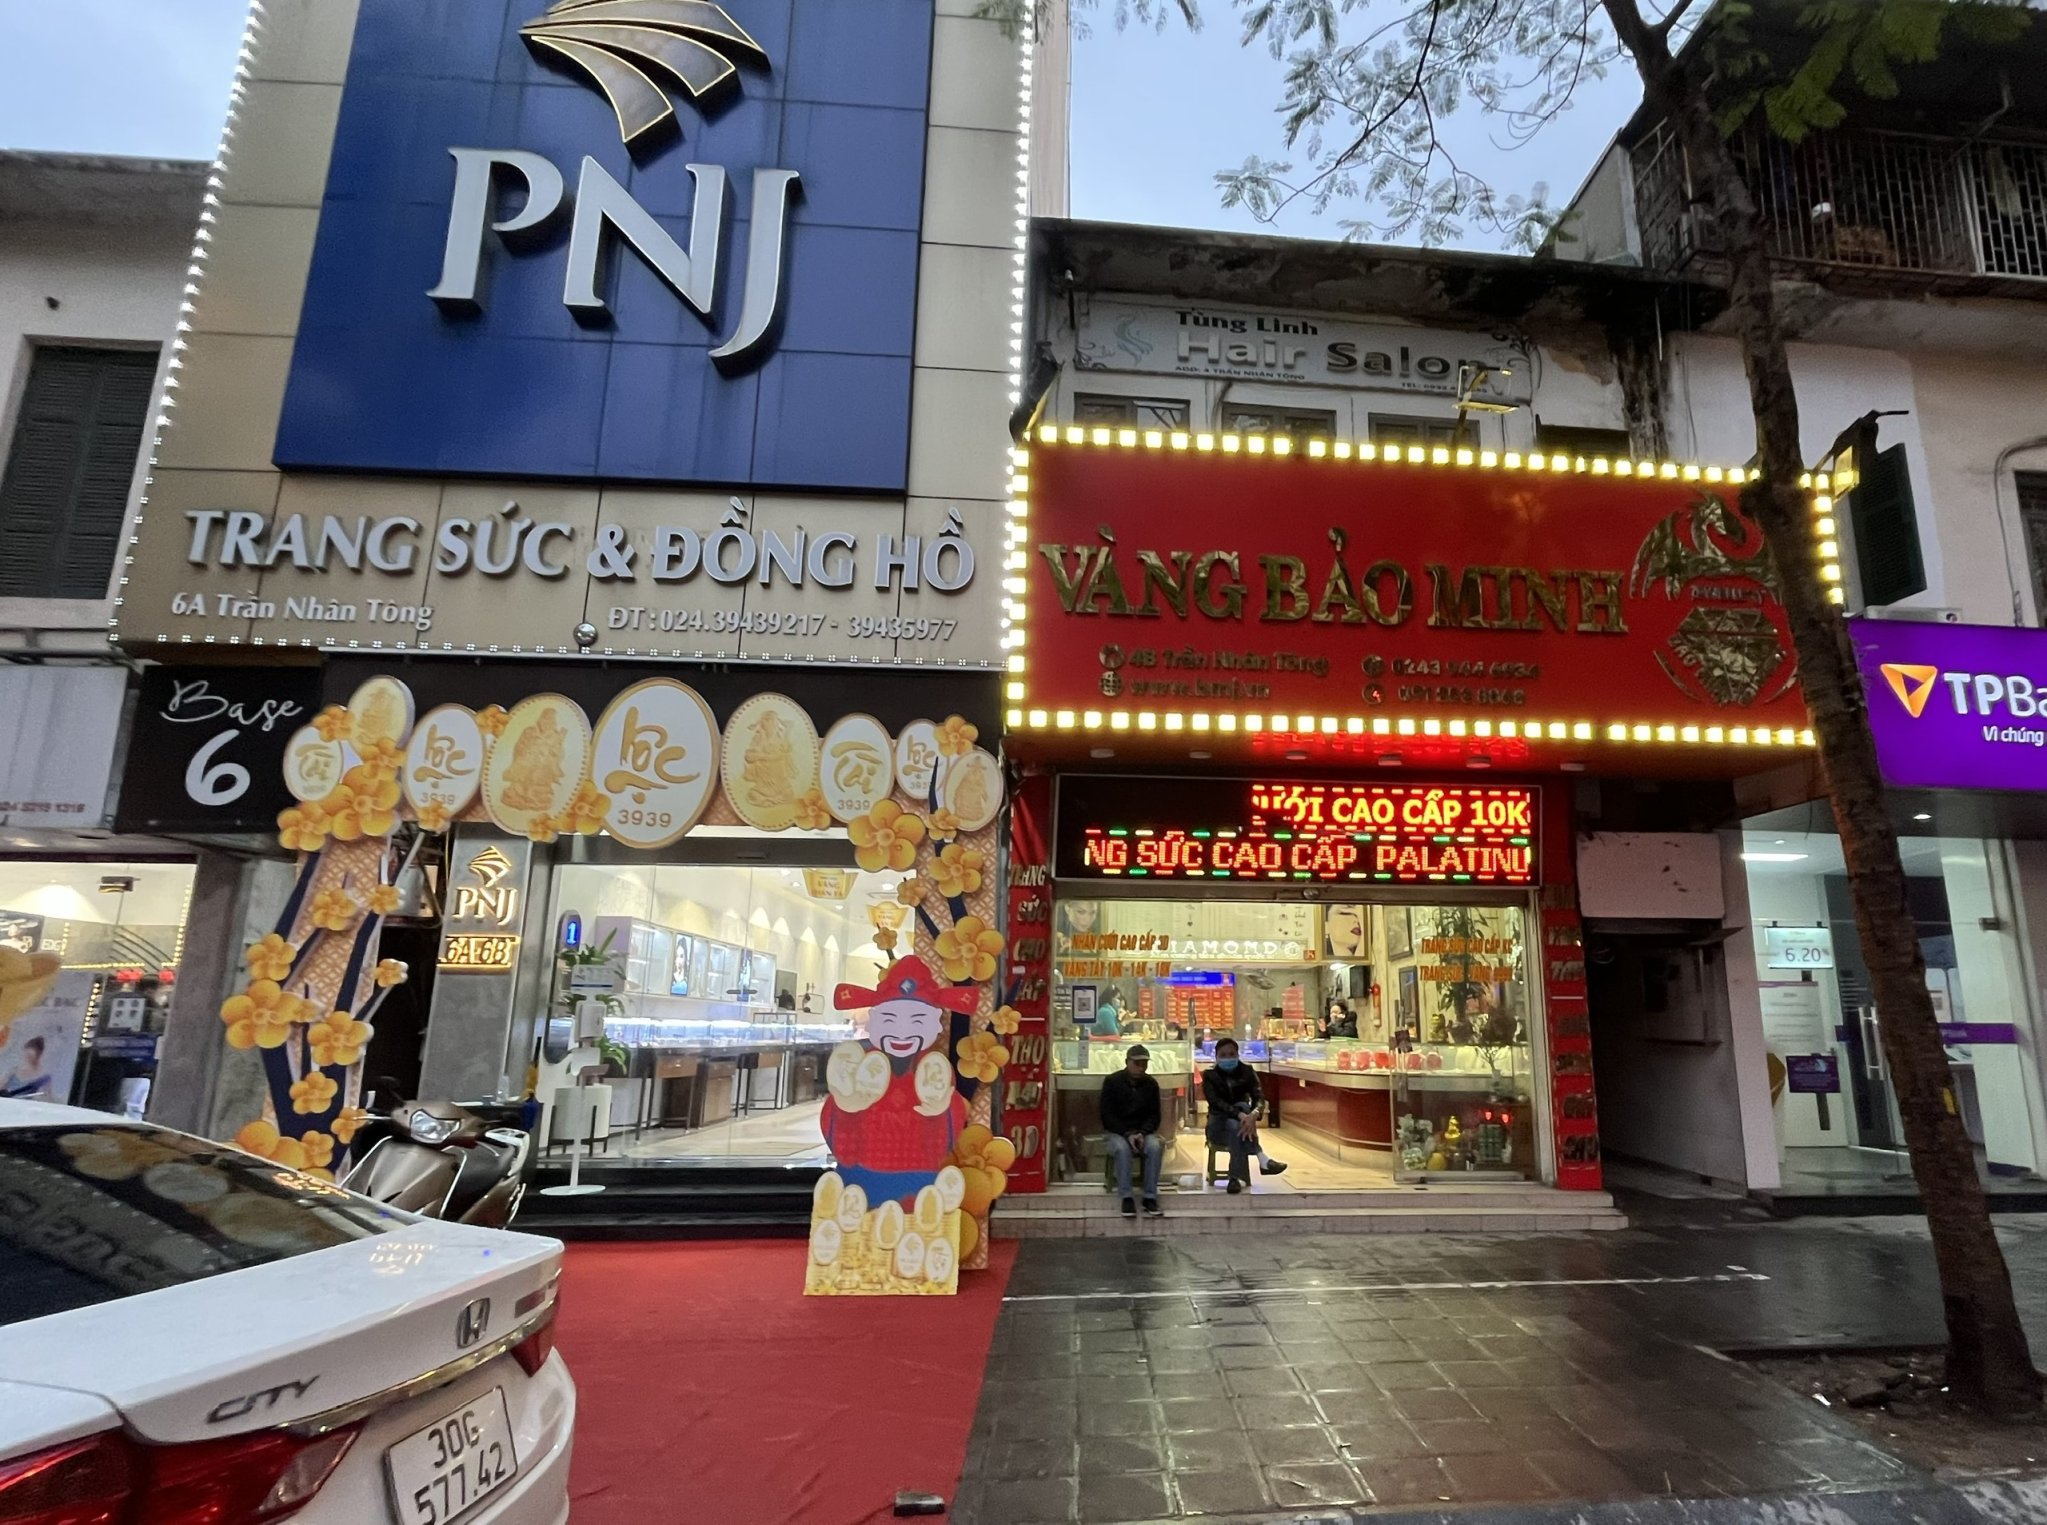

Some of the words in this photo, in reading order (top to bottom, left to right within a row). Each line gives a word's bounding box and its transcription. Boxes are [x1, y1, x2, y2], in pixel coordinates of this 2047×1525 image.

[425, 147, 800, 358] PNJ
[1178, 330, 1306, 369] Hair
[185, 510, 424, 574] TRANG
[435, 500, 575, 577] SỨC
[587, 523, 637, 580] &
[650, 495, 857, 588] ĐỒNG
[874, 506, 976, 592] HỒ
[1038, 523, 1249, 620] VÀNG
[1257, 525, 1414, 626] BẢO
[1424, 562, 1631, 634] MINH
[171, 592, 207, 617] 6A
[217, 588, 276, 620] Trần
[286, 596, 357, 622] Nhân
[365, 599, 434, 631] Tông
[847, 613, 958, 642] 39435977
[158, 679, 304, 732] Base
[2000, 726, 2045, 747] chúng
[184, 728, 251, 806] 6
[616, 809, 673, 829] 3939
[836, 799, 871, 811] 3939
[1331, 797, 1395, 825] CAO
[1402, 788, 1462, 826] CẤP
[1470, 799, 1529, 826] 10K
[1136, 833, 1204, 869] SỨC
[1212, 839, 1283, 870] CAO
[1291, 833, 1358, 871] CẤP
[1376, 844, 1531, 874] PALATINU
[450, 886, 518, 926] PNJ
[1119, 934, 1138, 951] CAO
[206, 1375, 320, 1423] CITY
[427, 1410, 481, 1470] 30G
[413, 1442, 507, 1525] 577.42
